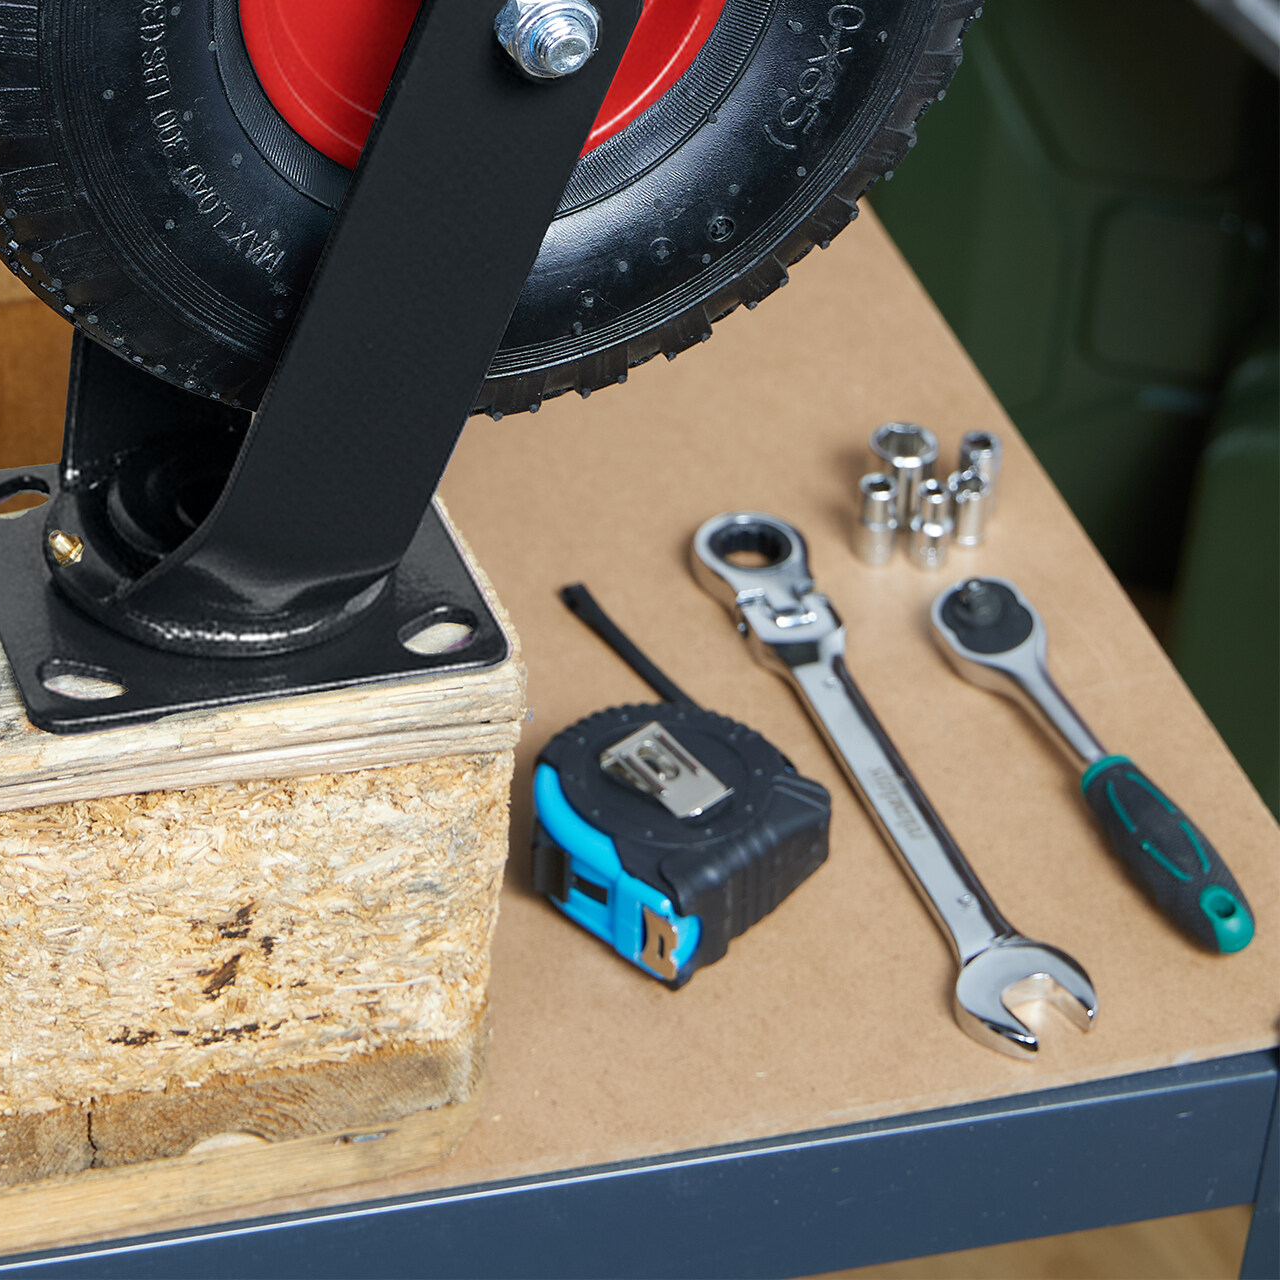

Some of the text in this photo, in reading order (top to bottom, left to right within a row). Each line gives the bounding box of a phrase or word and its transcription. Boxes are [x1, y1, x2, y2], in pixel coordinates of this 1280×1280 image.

[152, 109, 189, 158] 300
[180, 163, 234, 229] LOAD
[226, 221, 286, 274] MAX
